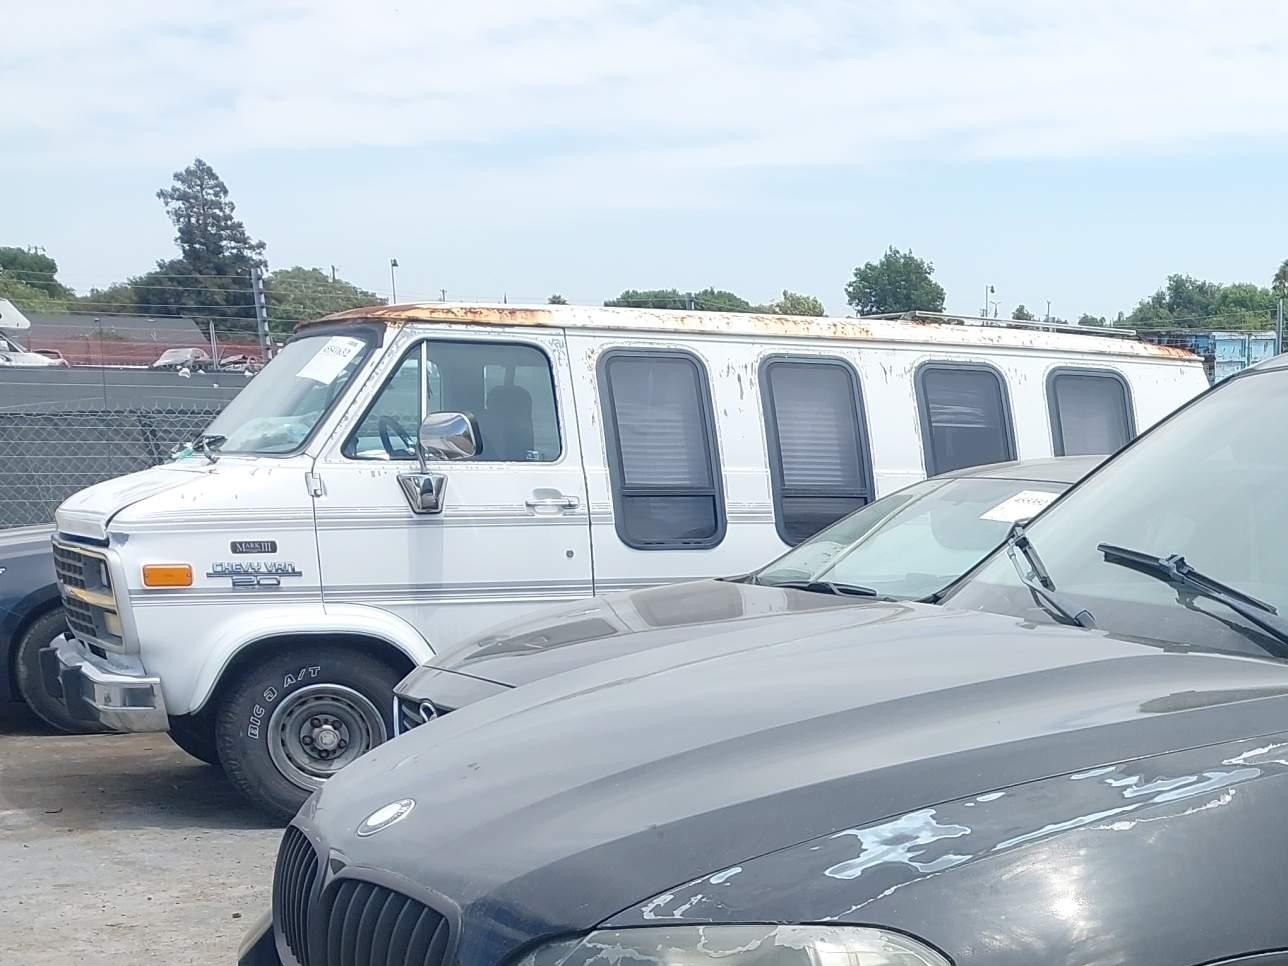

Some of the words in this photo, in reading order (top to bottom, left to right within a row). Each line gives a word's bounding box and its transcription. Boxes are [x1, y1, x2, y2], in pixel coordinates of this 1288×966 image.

[212, 561, 261, 573] CHEVY
[263, 561, 296, 573] VAN
[232, 576, 281, 586] 20
[283, 666, 321, 688] A/T
